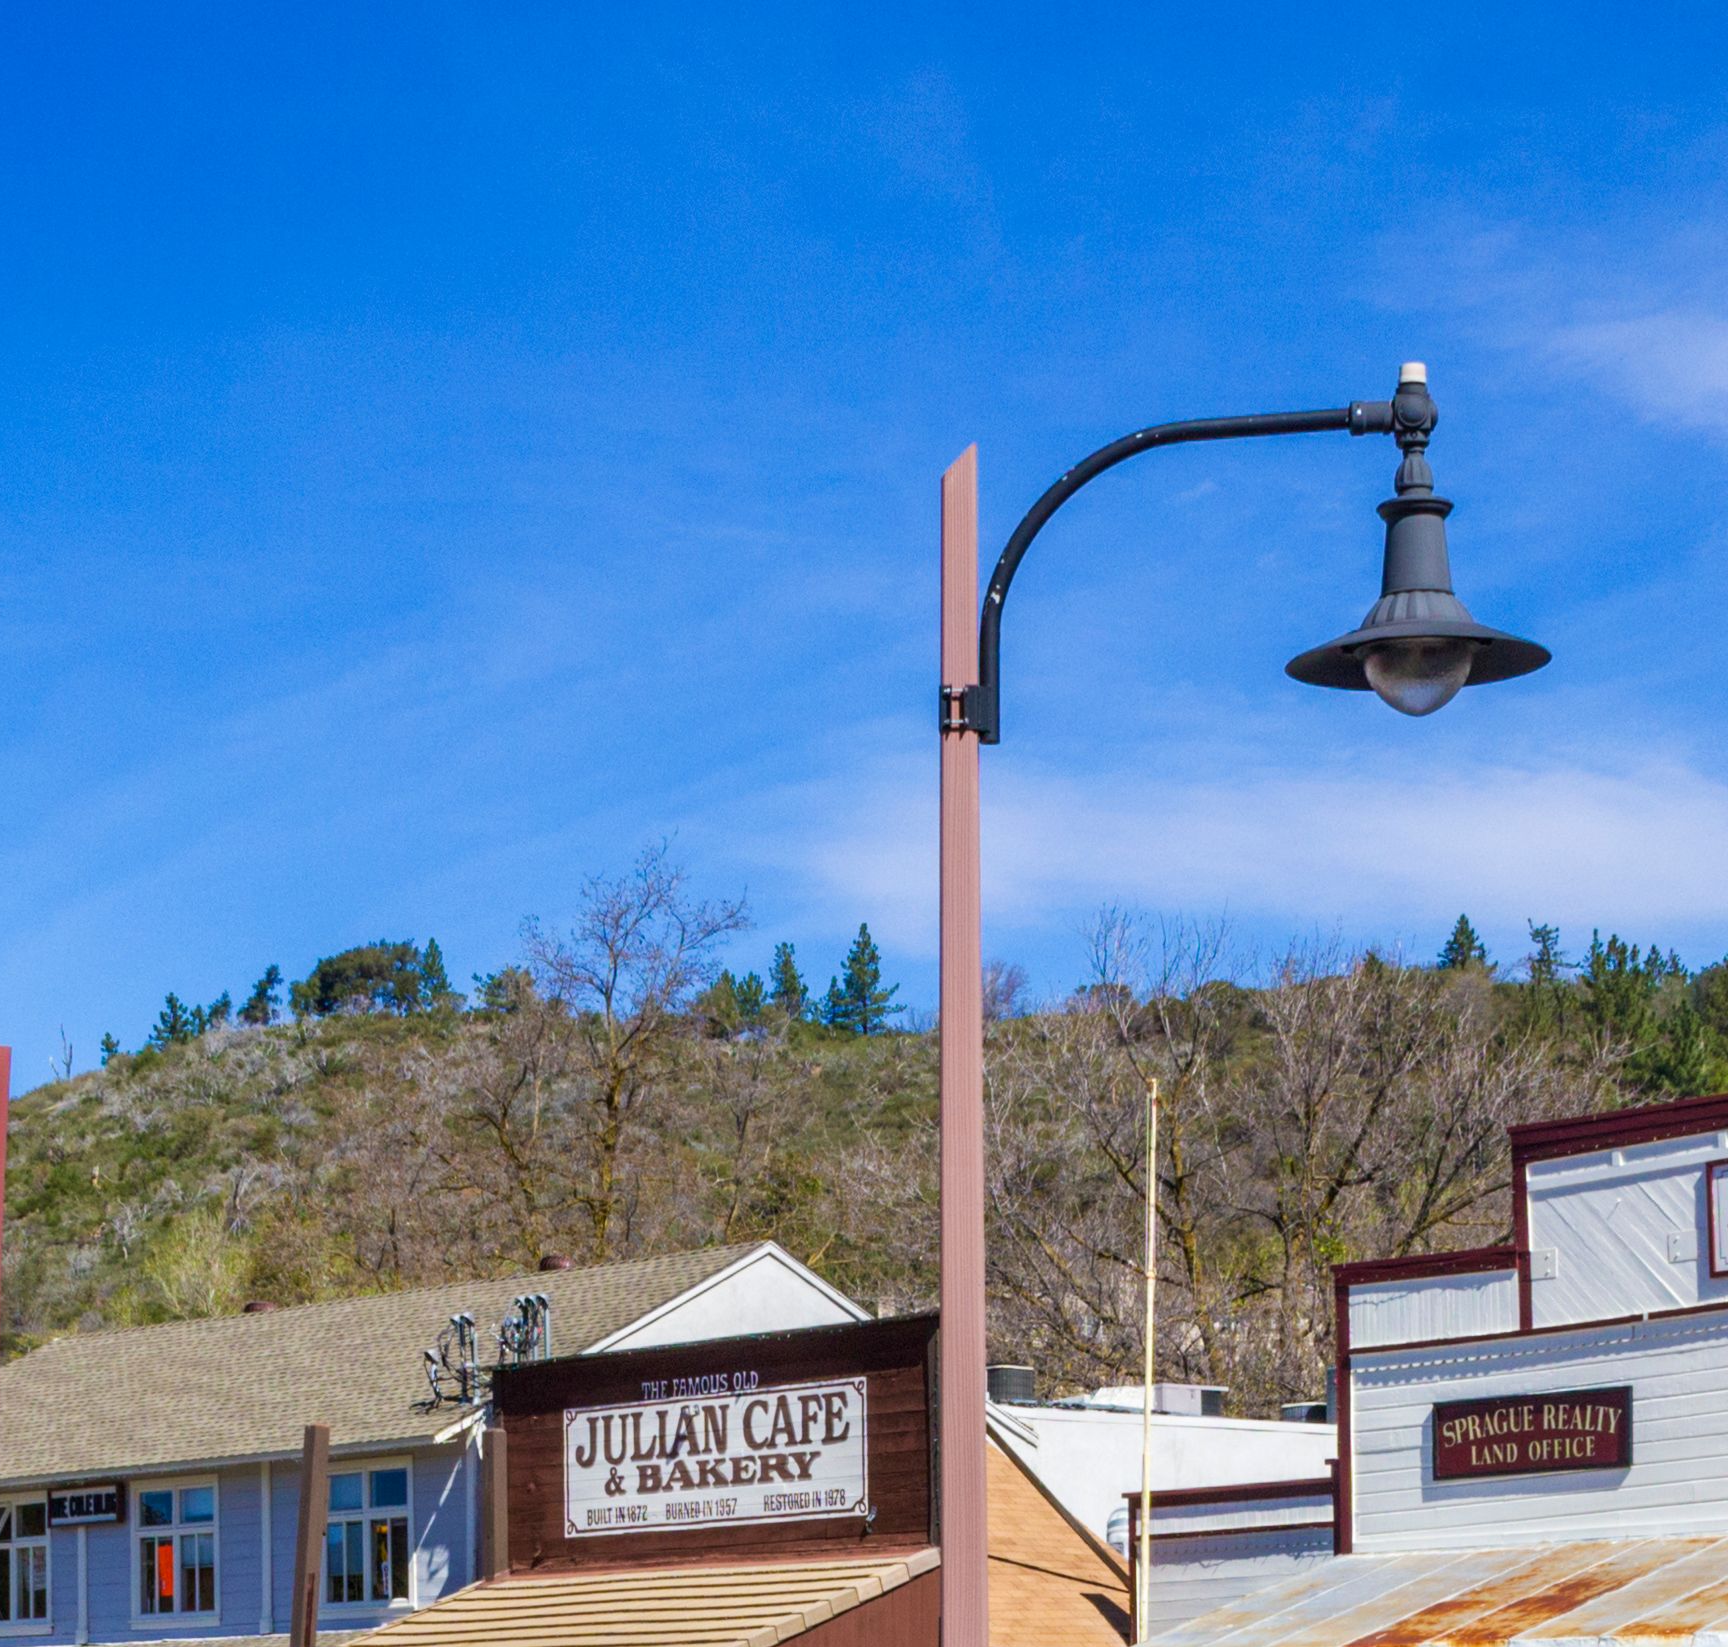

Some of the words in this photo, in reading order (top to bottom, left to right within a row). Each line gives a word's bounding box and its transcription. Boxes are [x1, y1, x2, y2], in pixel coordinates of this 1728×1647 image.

[641, 1380, 667, 1400] THE
[672, 1374, 729, 1398] FAMOUS
[732, 1371, 759, 1391] OLD
[575, 1403, 730, 1469] JULIAN
[742, 1390, 851, 1452] CAFE
[1442, 1404, 1535, 1450] SPRAGUE
[1541, 1401, 1623, 1436] REALTY
[1470, 1440, 1519, 1468] LAND
[1528, 1435, 1597, 1462] OFFICE
[603, 1466, 627, 1498] &
[636, 1450, 822, 1496] BAKERY
[586, 1507, 612, 1526] BUILT
[614, 1506, 627, 1524] IN
[626, 1504, 648, 1523] 1872
[665, 1501, 701, 1520] BURNED
[702, 1499, 714, 1518] IN
[714, 1498, 738, 1517] 1957
[763, 1493, 811, 1512] RESTORED
[812, 1491, 822, 1508] IN
[823, 1488, 847, 1507] 1978
